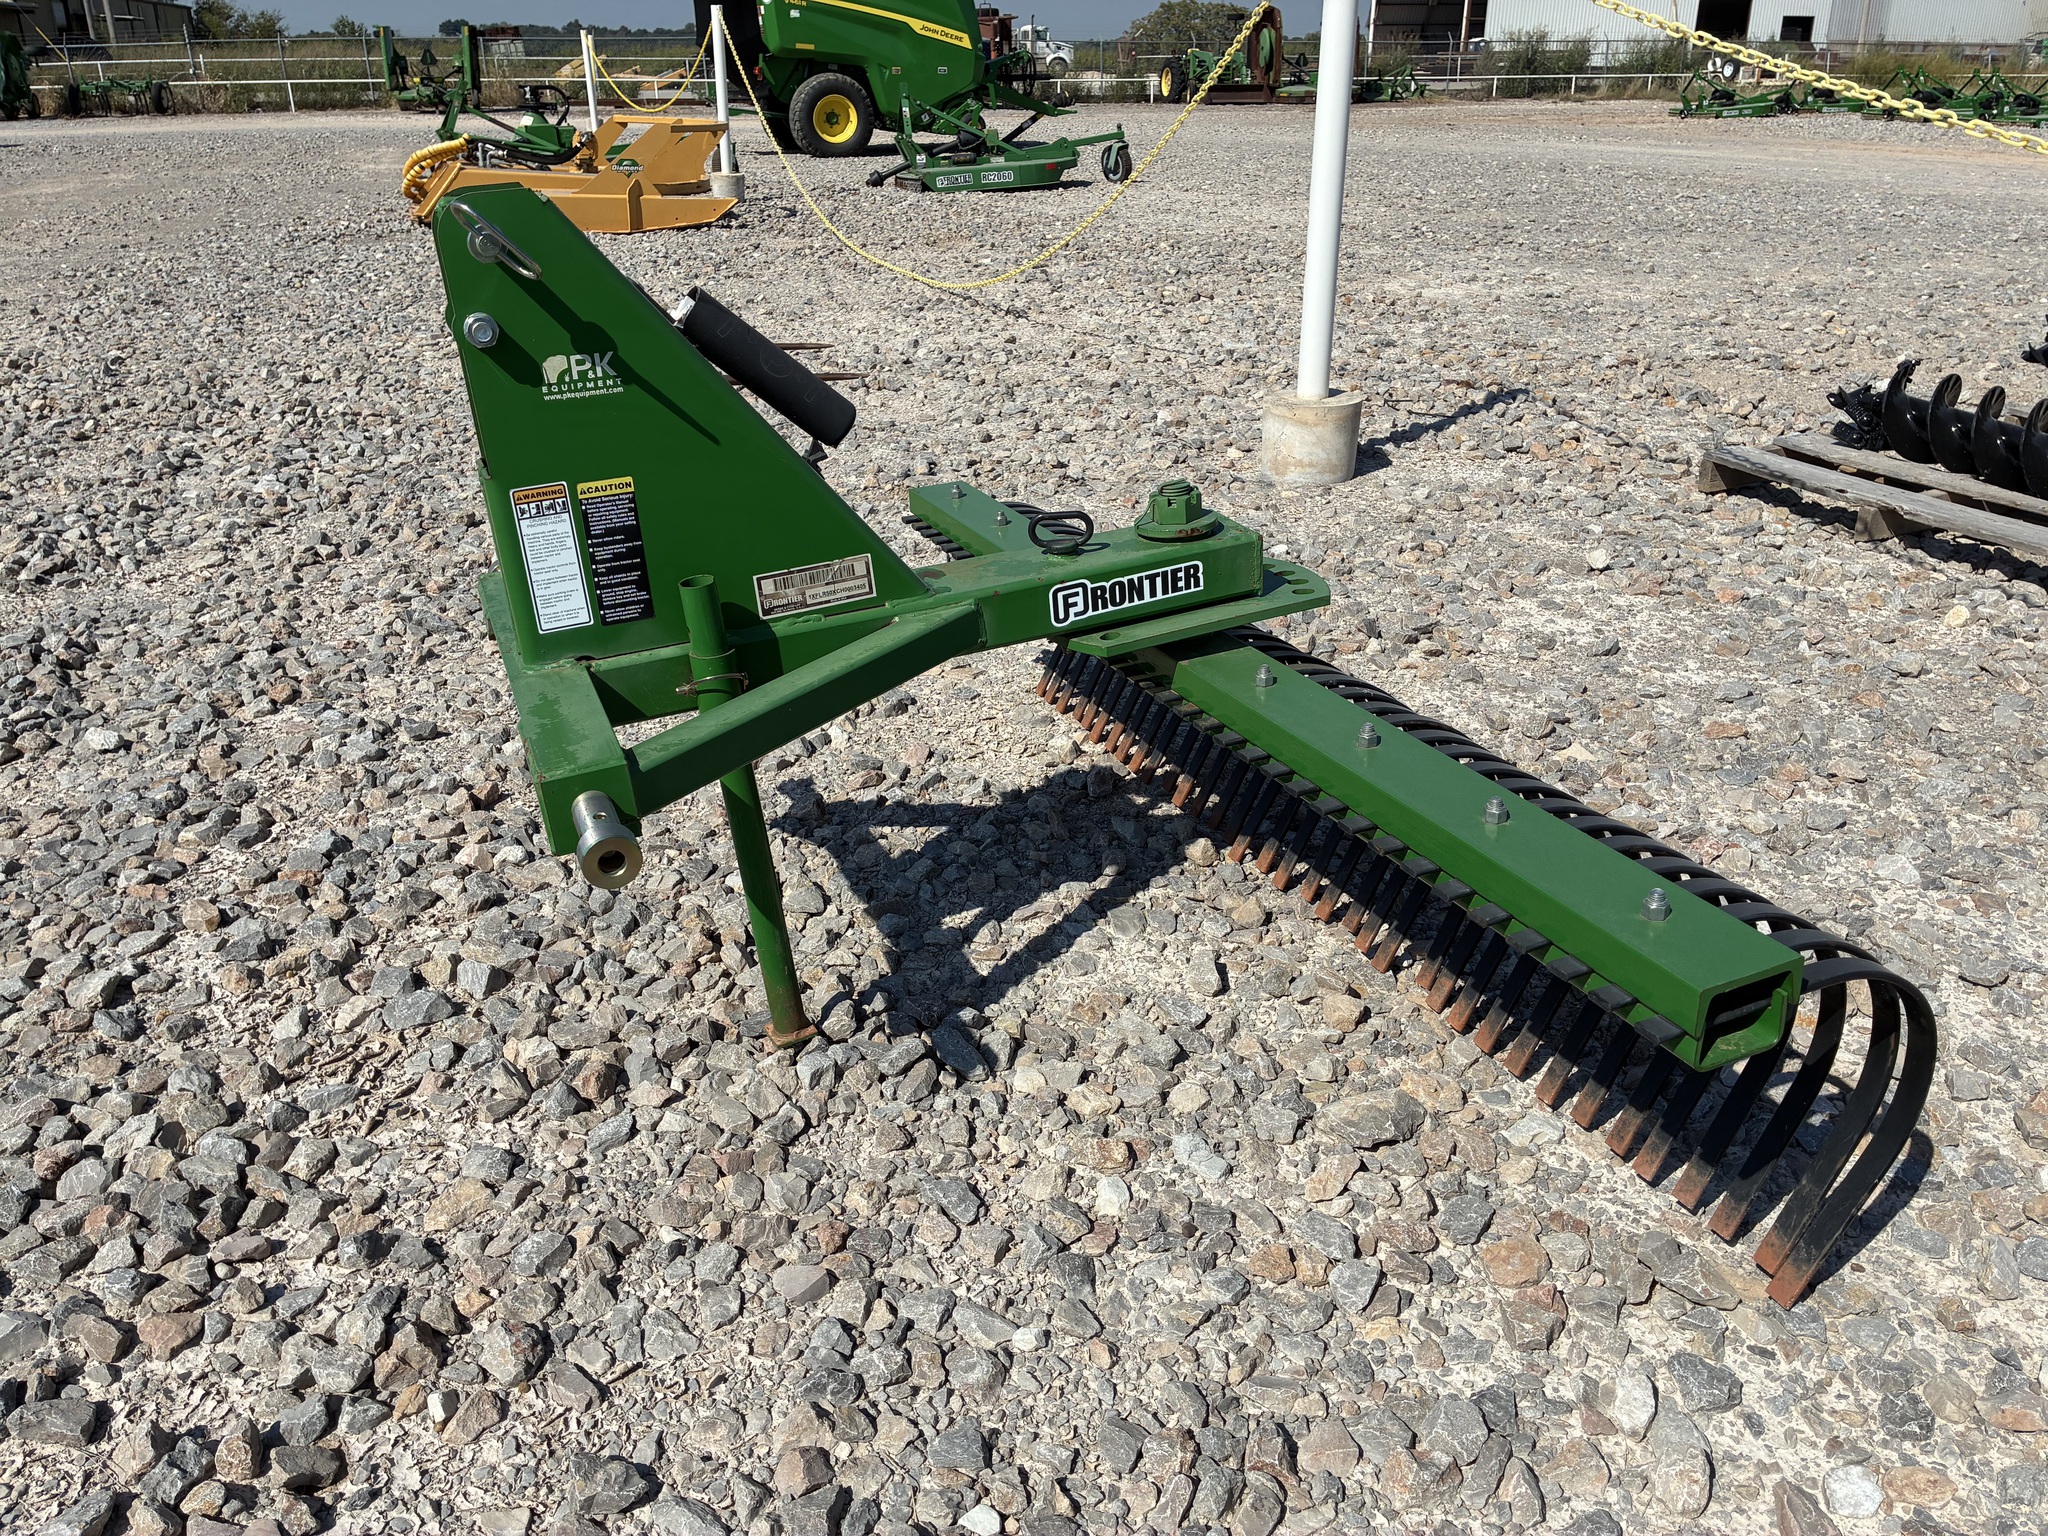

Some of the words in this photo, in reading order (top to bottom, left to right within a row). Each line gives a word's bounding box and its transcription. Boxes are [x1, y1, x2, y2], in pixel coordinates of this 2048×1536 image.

[920, 24, 940, 36] JOHN
[940, 30, 965, 43] DEERE
[981, 171, 1013, 182] RC2060
[570, 351, 618, 380] P&K
[542, 378, 622, 393] EQUIPMENT
[543, 387, 624, 400] www.pkequipment.com
[522, 489, 563, 500] WARNING
[587, 482, 632, 494] CAUTION
[1051, 563, 1202, 625] FRONTIER
[764, 595, 803, 609] FRONTIER
